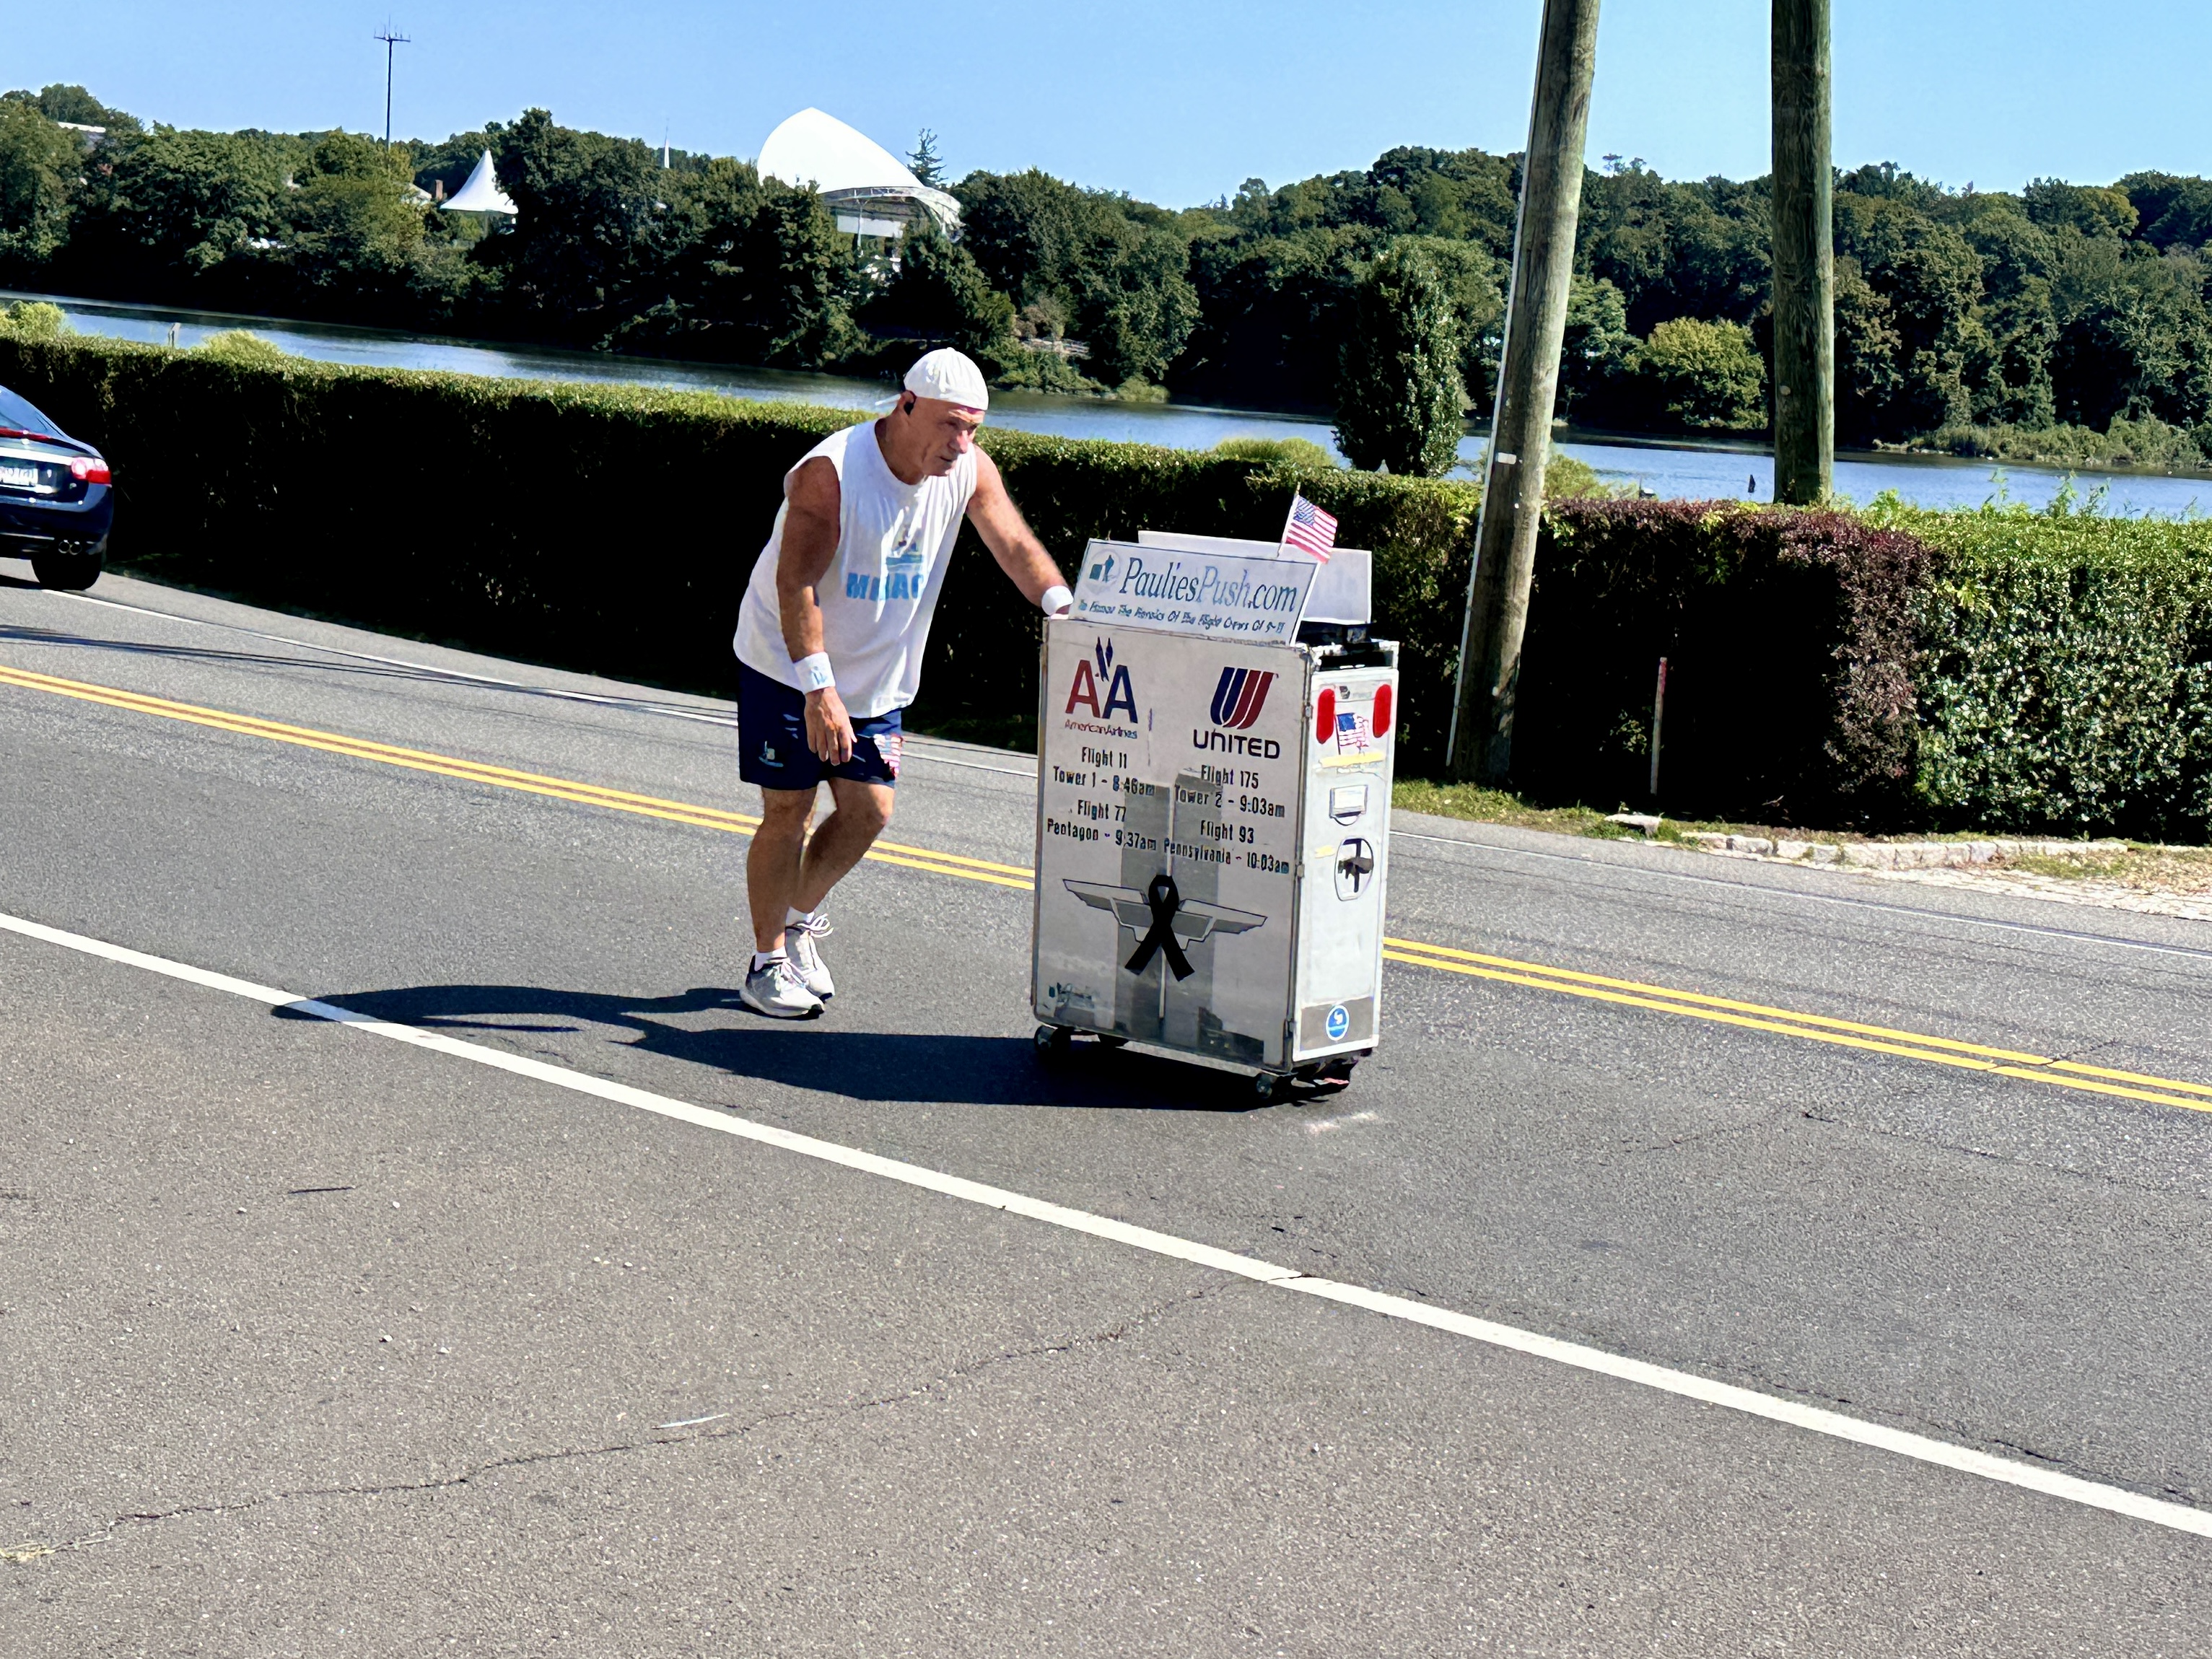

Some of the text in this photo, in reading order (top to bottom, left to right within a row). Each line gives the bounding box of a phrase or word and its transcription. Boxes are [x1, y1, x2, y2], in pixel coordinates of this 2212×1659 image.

[1119, 556, 1298, 612] PauliesPush.com
[1082, 747, 1127, 769] Flight 11
[1193, 728, 1280, 759] UNITED
[1053, 766, 1086, 786] Tower
[1092, 772, 1096, 787] 1
[1112, 775, 1155, 796] 8:46am
[1201, 764, 1259, 789] Flight 175
[1077, 800, 1127, 822] Flight 77
[1174, 784, 1209, 805] Tower
[1215, 793, 1223, 807] 2
[1240, 795, 1285, 818] 9:03am
[1047, 818, 1098, 841] Pentagon
[1115, 829, 1156, 851] 9:37am
[1201, 820, 1254, 844] Flight 93
[1163, 838, 1231, 864] Pennsylvania
[1247, 852, 1290, 874] 10:03am
